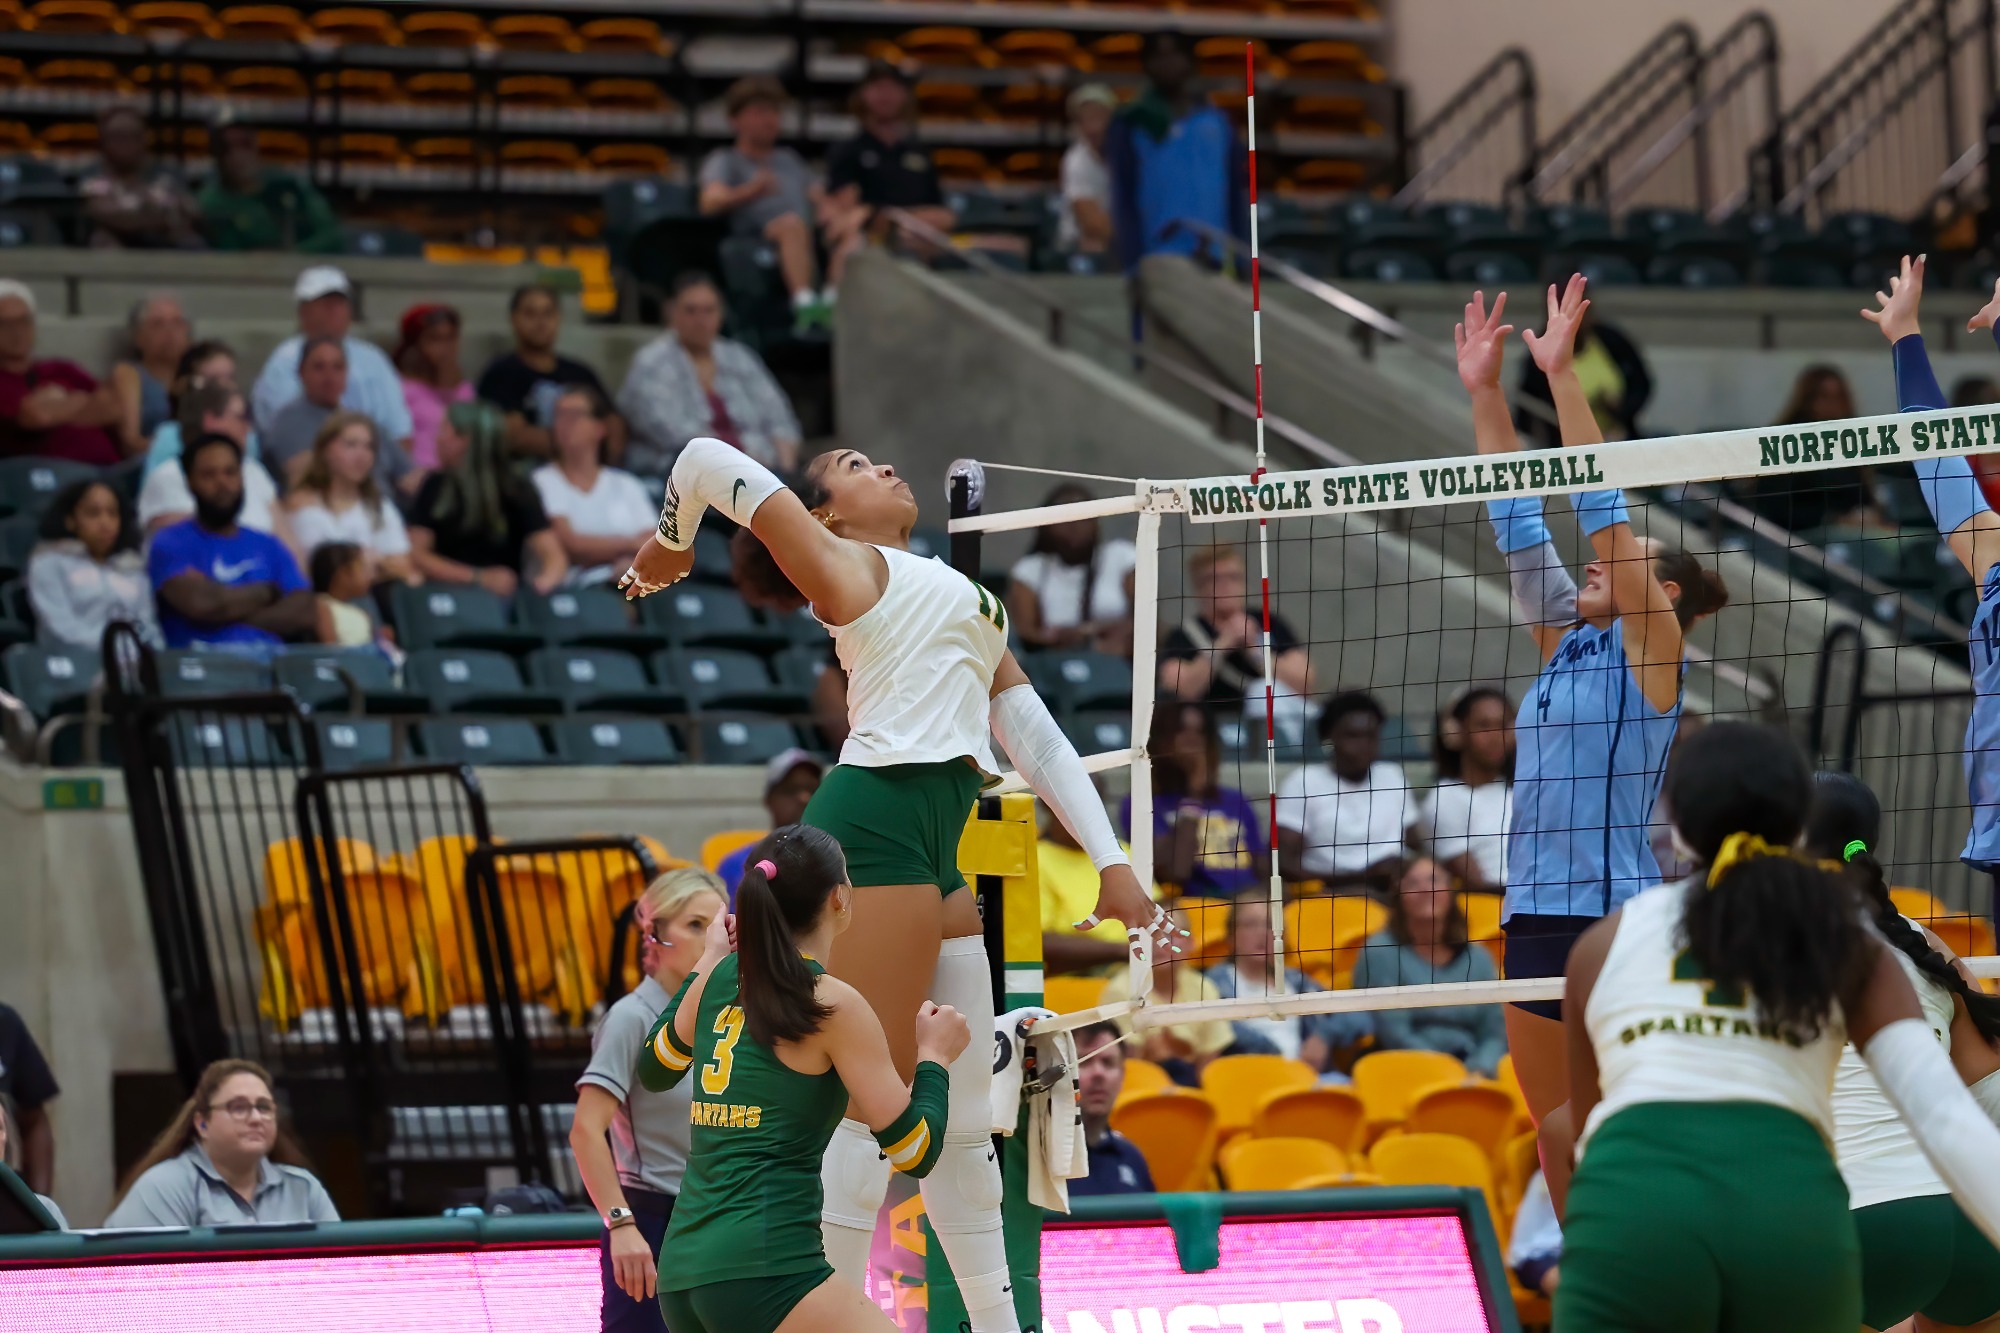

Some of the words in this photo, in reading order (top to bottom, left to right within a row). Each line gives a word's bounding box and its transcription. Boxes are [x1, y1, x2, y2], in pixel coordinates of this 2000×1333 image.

[1759, 424, 1900, 467] NORFOLK
[1189, 480, 1312, 515] NORFOLK
[1323, 471, 1410, 507] STATE
[1419, 454, 1604, 499] VOLLEYBALL
[701, 1005, 746, 1095] 3
